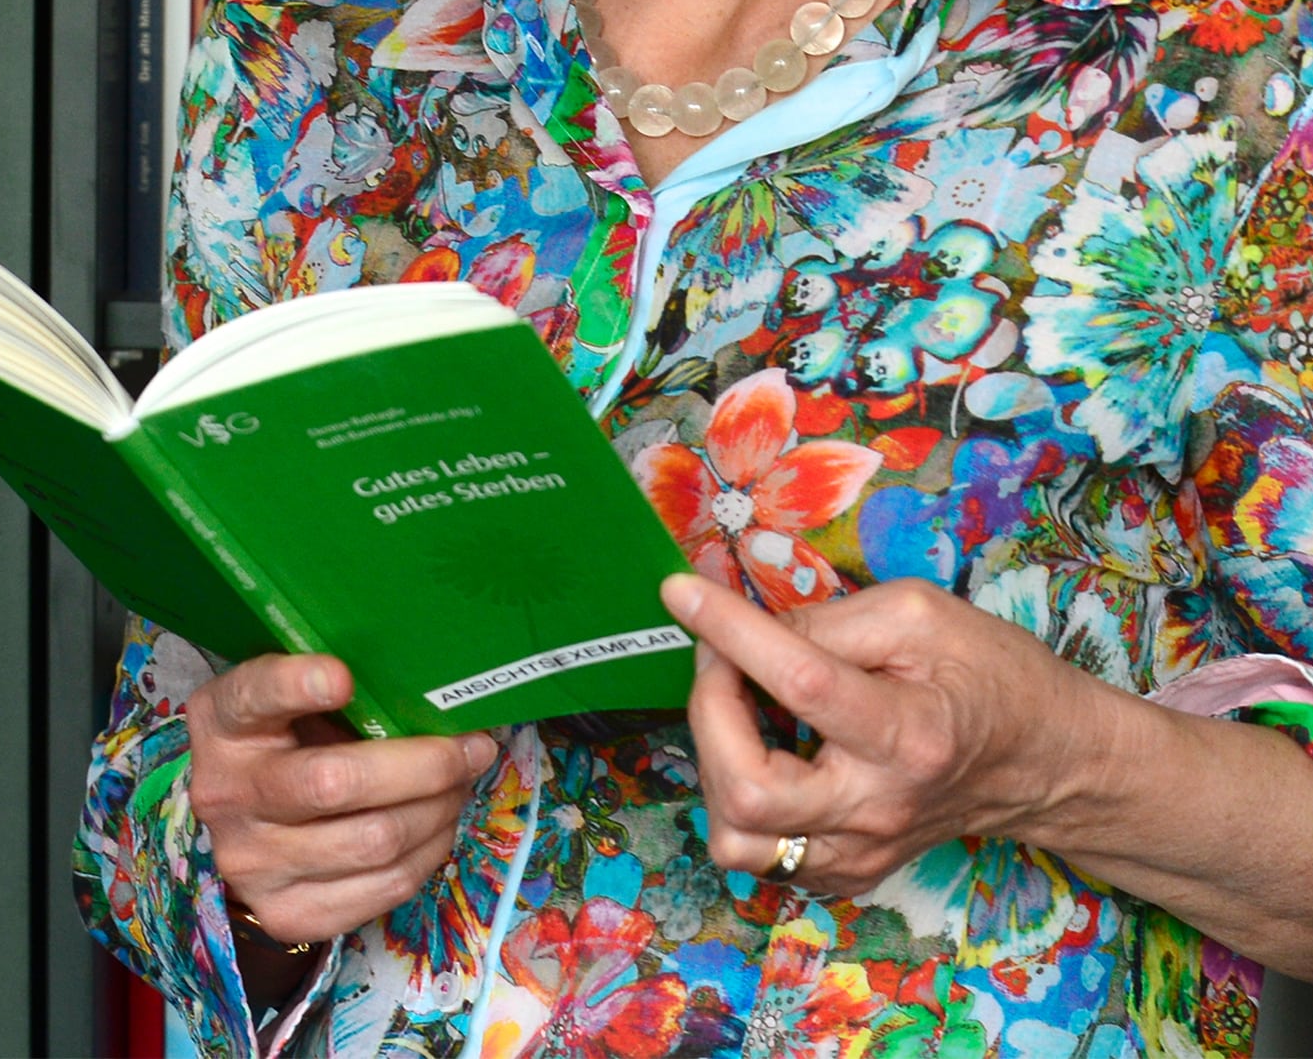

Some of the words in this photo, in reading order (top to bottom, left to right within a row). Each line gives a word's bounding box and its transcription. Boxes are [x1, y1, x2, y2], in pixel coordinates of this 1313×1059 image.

[138, 33, 151, 56] alte
[138, 59, 152, 82] Der
[352, 461, 439, 498] Gutes
[438, 448, 529, 479] Leben
[372, 489, 454, 525] gutes
[451, 469, 568, 504] Sterben
[440, 630, 682, 704] ANSICHTSEXEMPLAR
